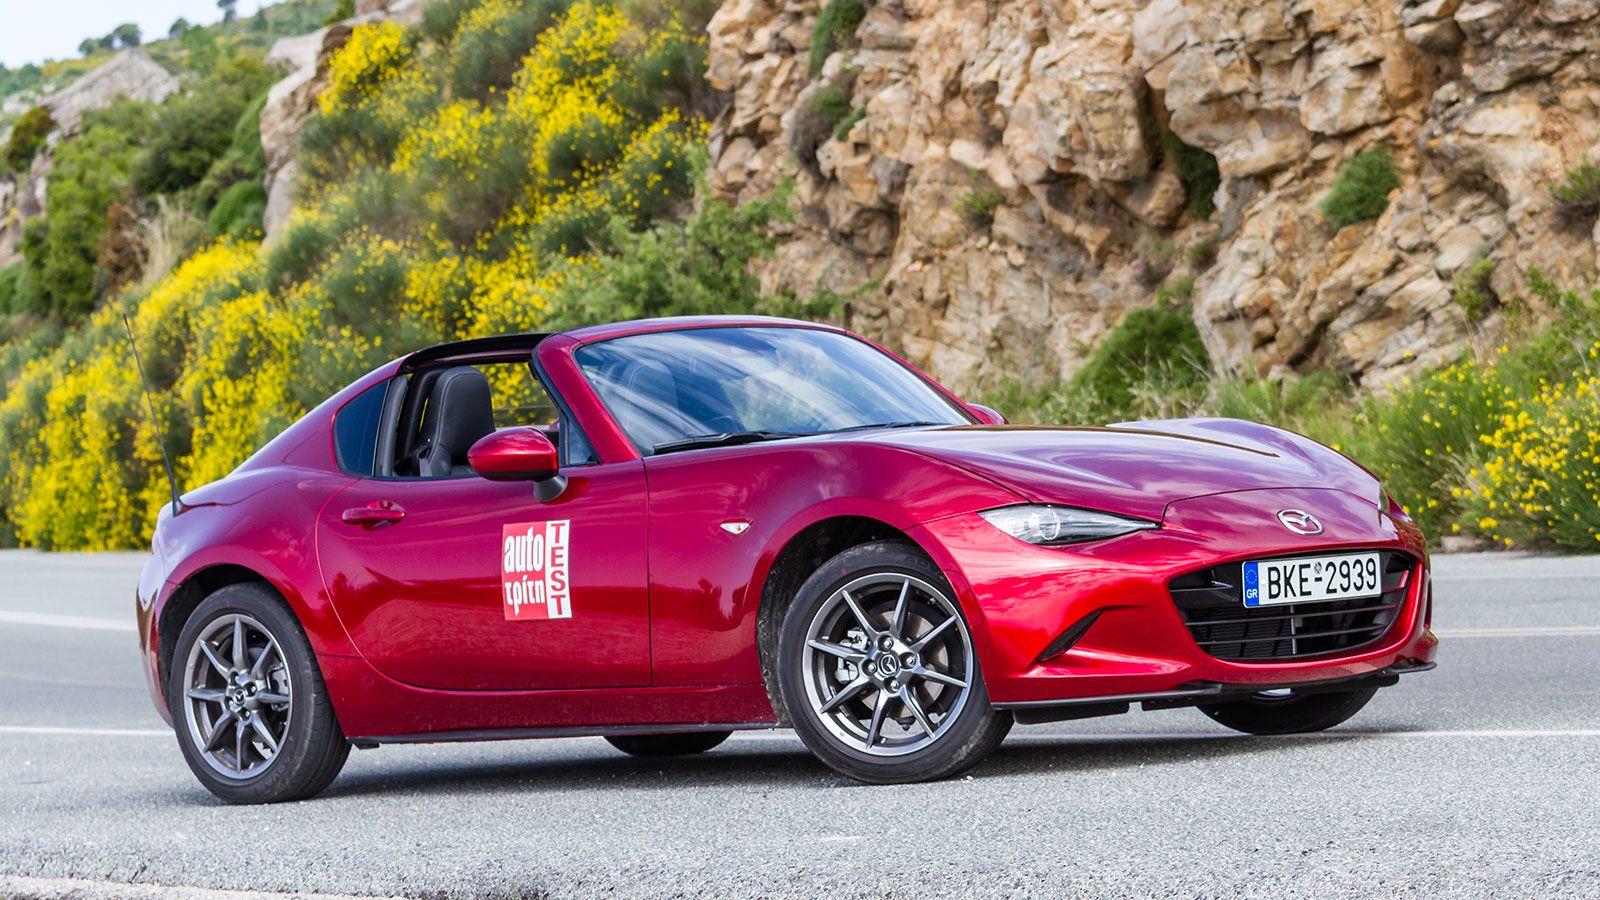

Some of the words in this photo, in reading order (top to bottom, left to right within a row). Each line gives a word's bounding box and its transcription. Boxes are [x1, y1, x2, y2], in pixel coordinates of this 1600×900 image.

[504, 527, 544, 573] auto
[550, 523, 566, 615] TEST
[504, 574, 545, 616] τρίτη
[1246, 588, 1258, 599] GR
